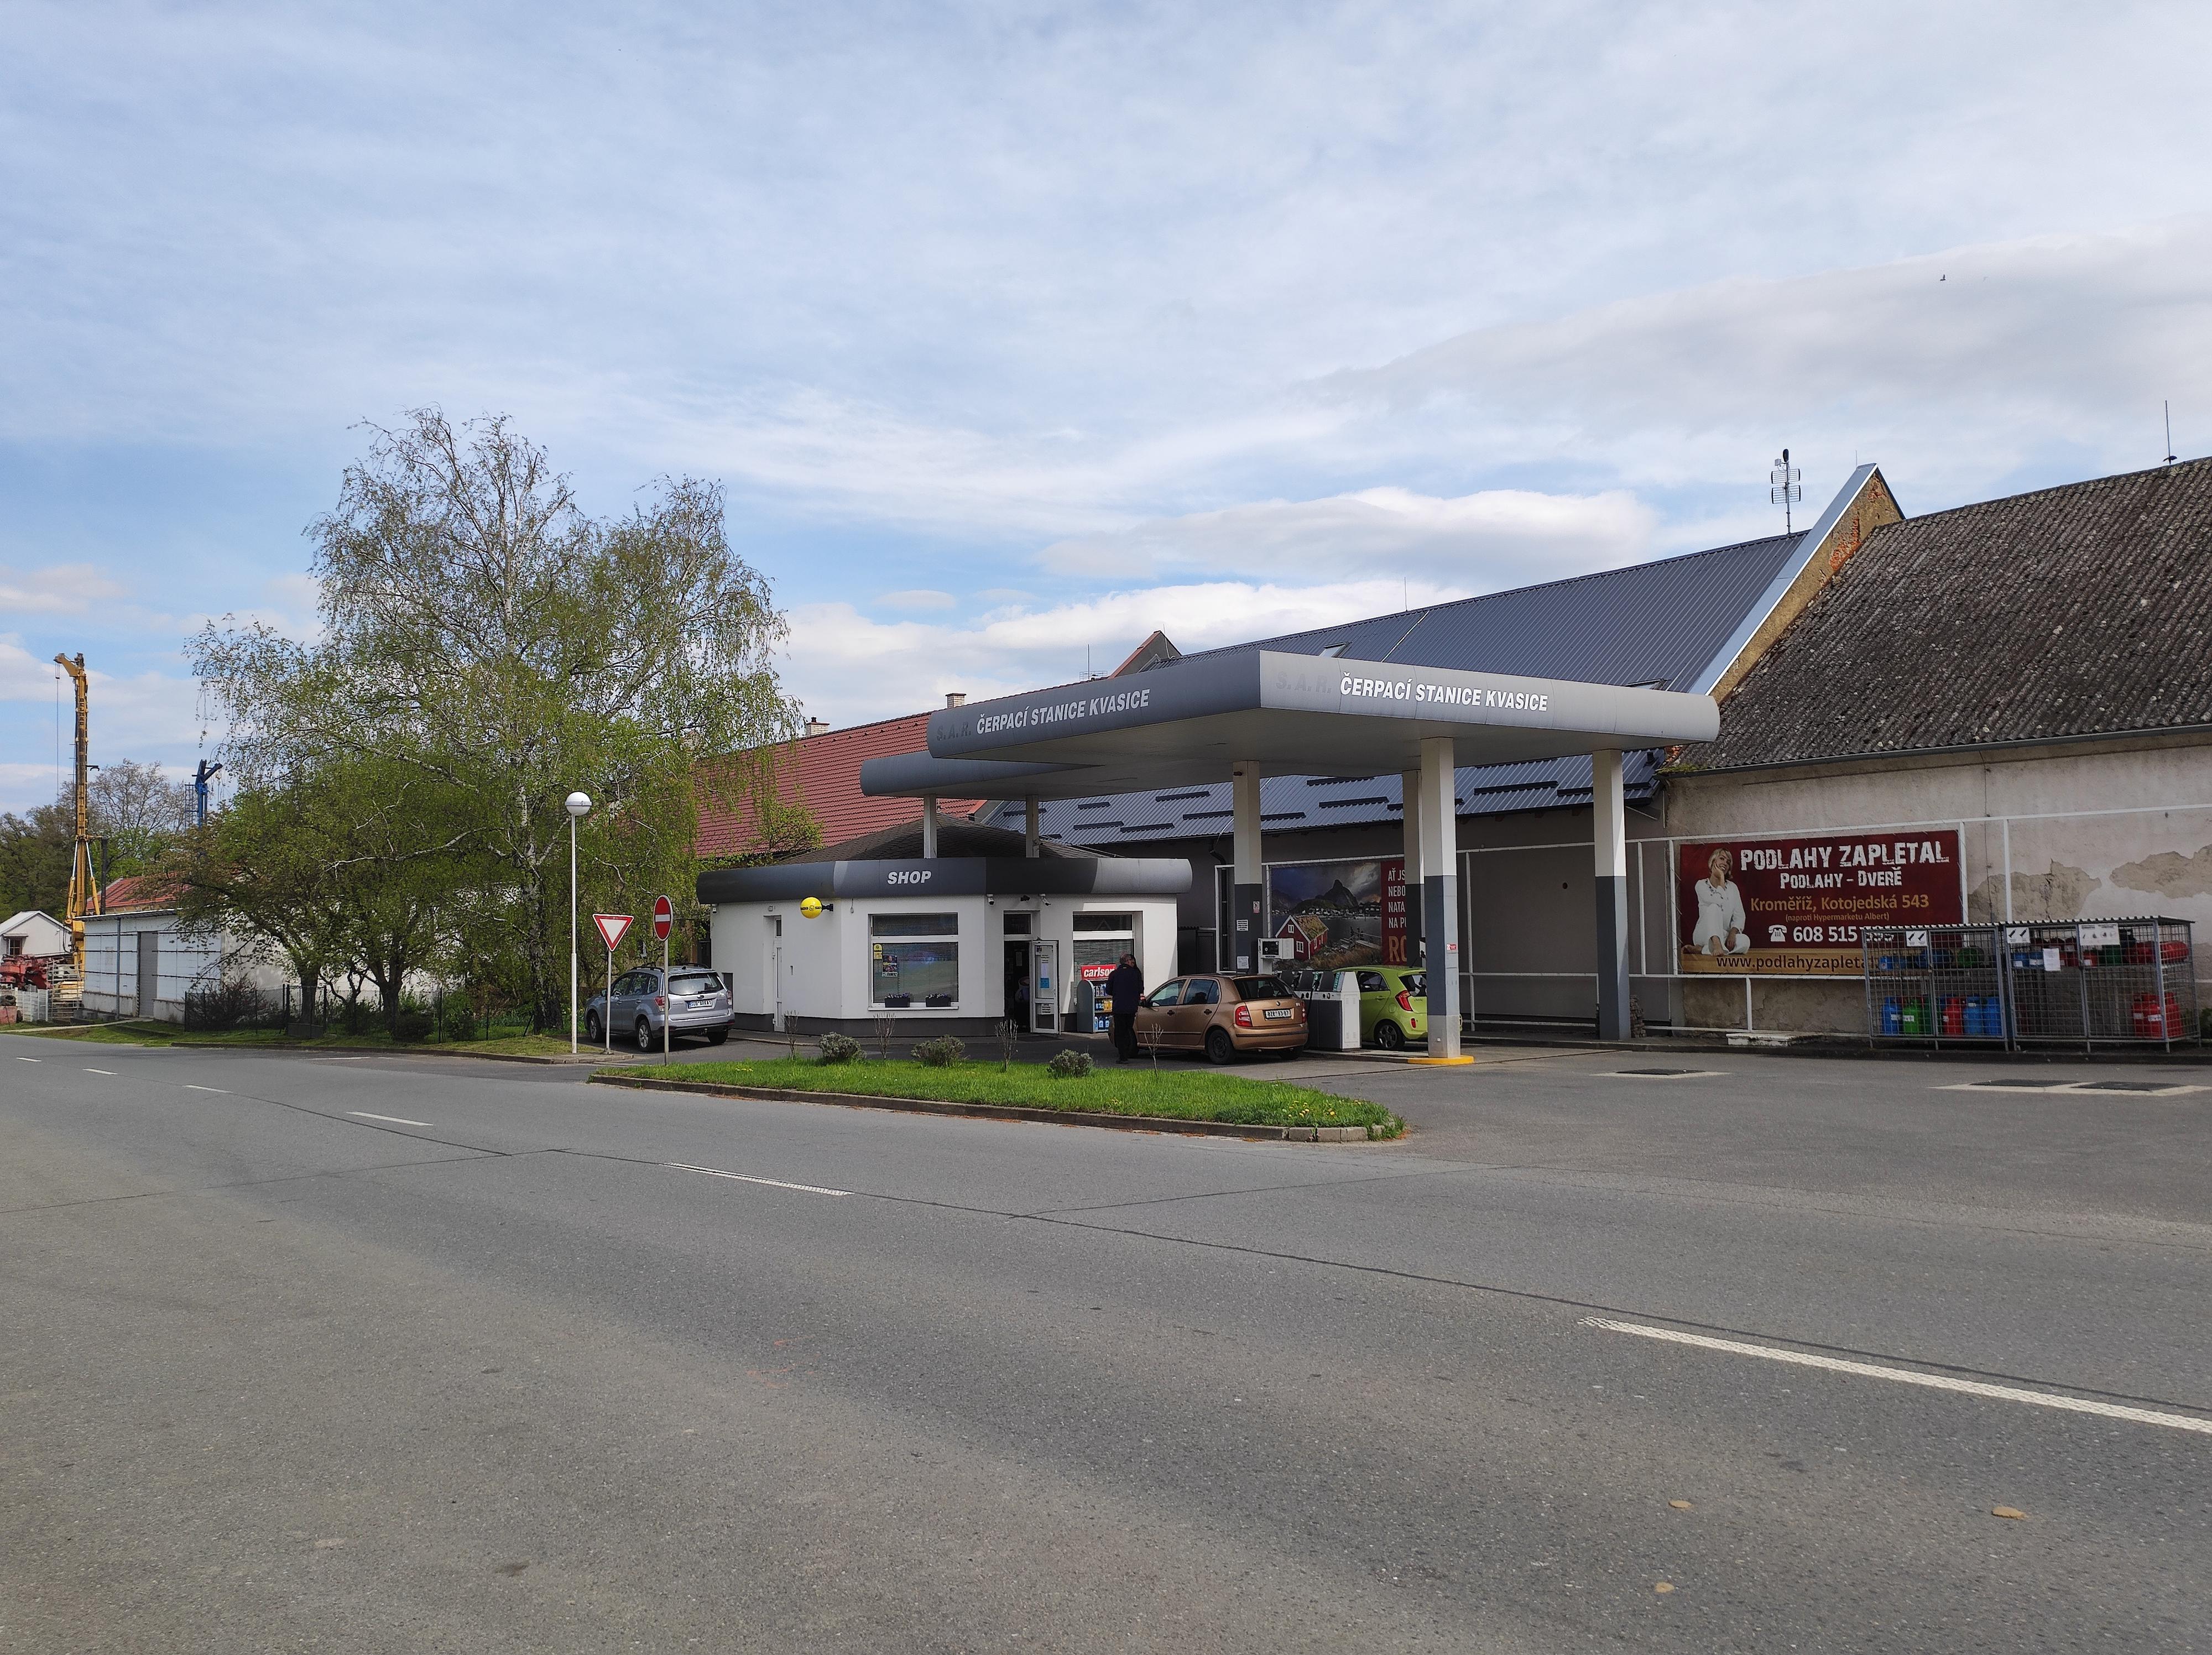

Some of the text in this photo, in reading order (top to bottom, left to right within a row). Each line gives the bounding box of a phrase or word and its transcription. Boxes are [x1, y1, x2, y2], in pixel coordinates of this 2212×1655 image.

[1340, 671, 1412, 700] ČERPACÍ
[1415, 683, 1482, 706] STANICE
[1485, 690, 1548, 712] KVASICE
[977, 706, 1030, 735] ČERPACÍ
[1031, 700, 1086, 726] STANICE
[1089, 688, 1150, 716] KVASICE
[1740, 840, 1950, 871] PODLAHY ZAPLETAL
[887, 870, 932, 885] SHOP
[1780, 873, 1843, 889] PODLAHY
[1388, 885, 1406, 897] NEBO
[1751, 894, 1929, 912] Kroměříž, Kotojedská 543
[1389, 917, 1399, 928] NA
[1785, 912, 1890, 922] (naproti Hypermarketu Albert)
[1793, 926, 1824, 942] 608
[1828, 926, 1858, 942] 515
